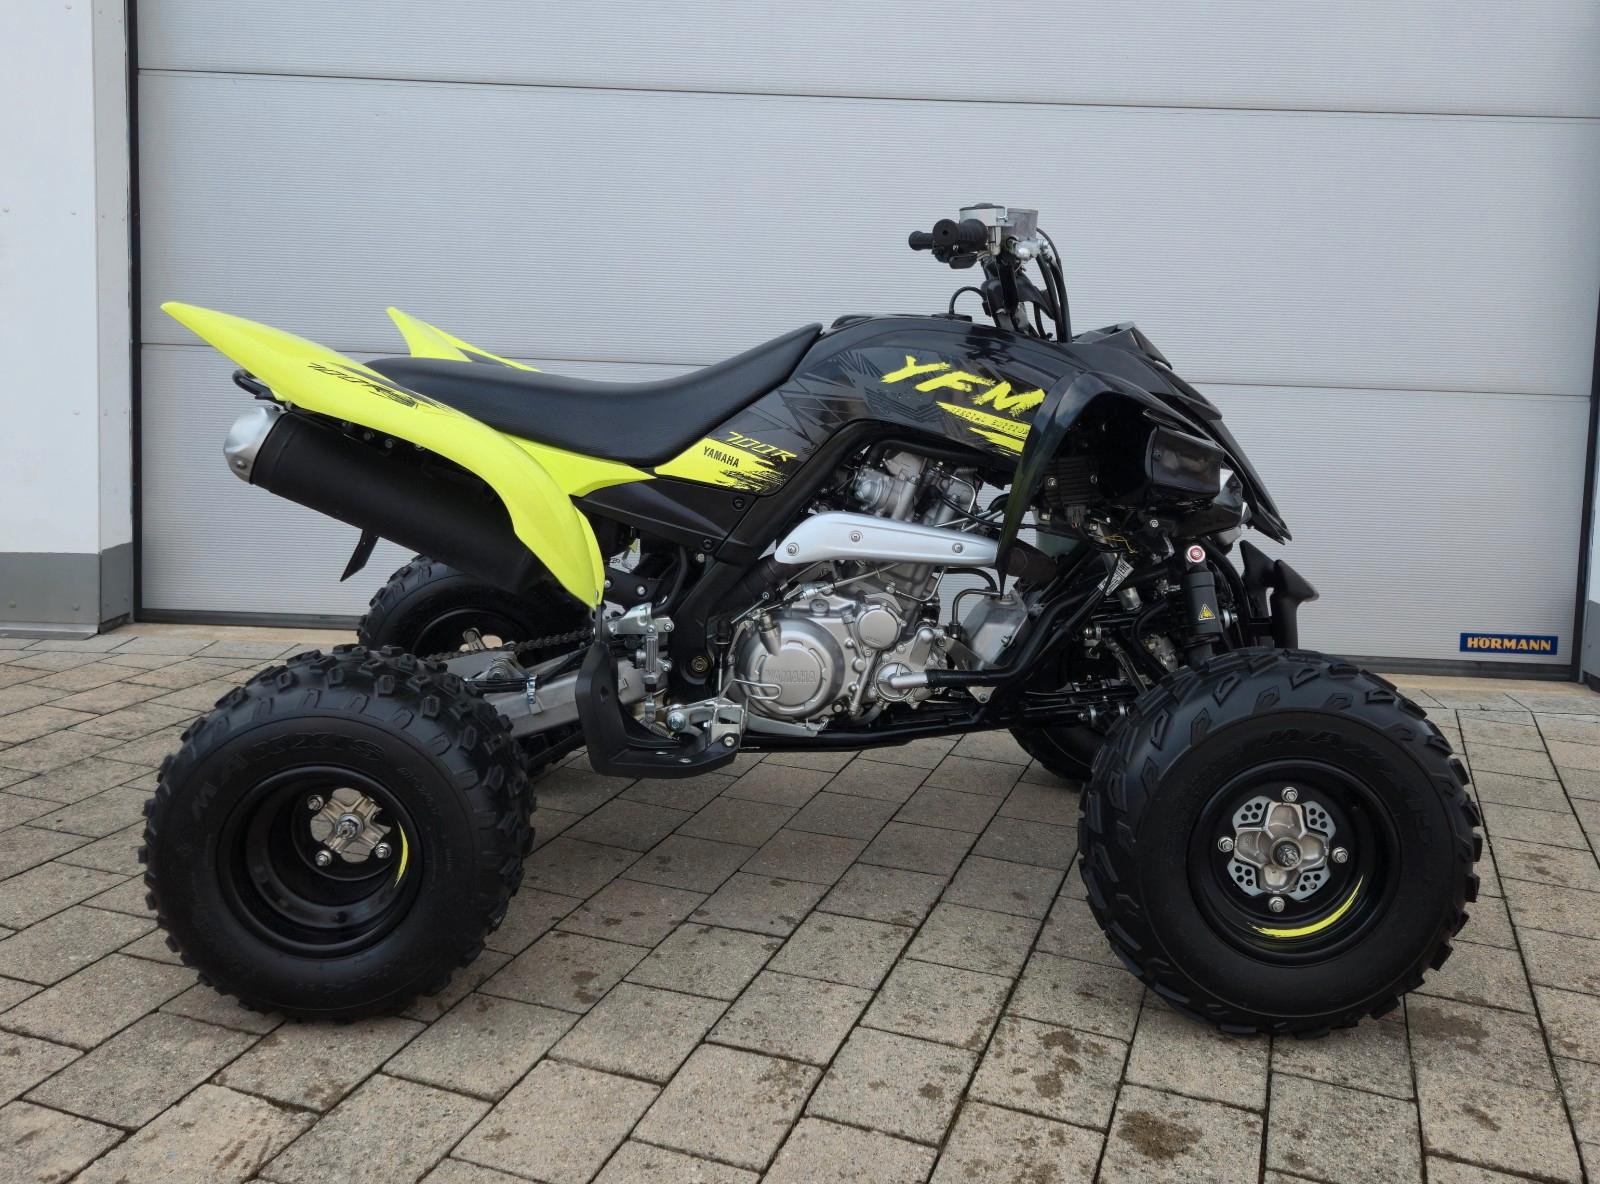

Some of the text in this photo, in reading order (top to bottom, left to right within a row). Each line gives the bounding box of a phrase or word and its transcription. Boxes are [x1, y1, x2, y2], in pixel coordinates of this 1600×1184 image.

[880, 355, 1046, 417] YFM
[703, 446, 740, 468] YAMAHA
[726, 431, 797, 462] 700R
[765, 669, 816, 684] YAMAHA
